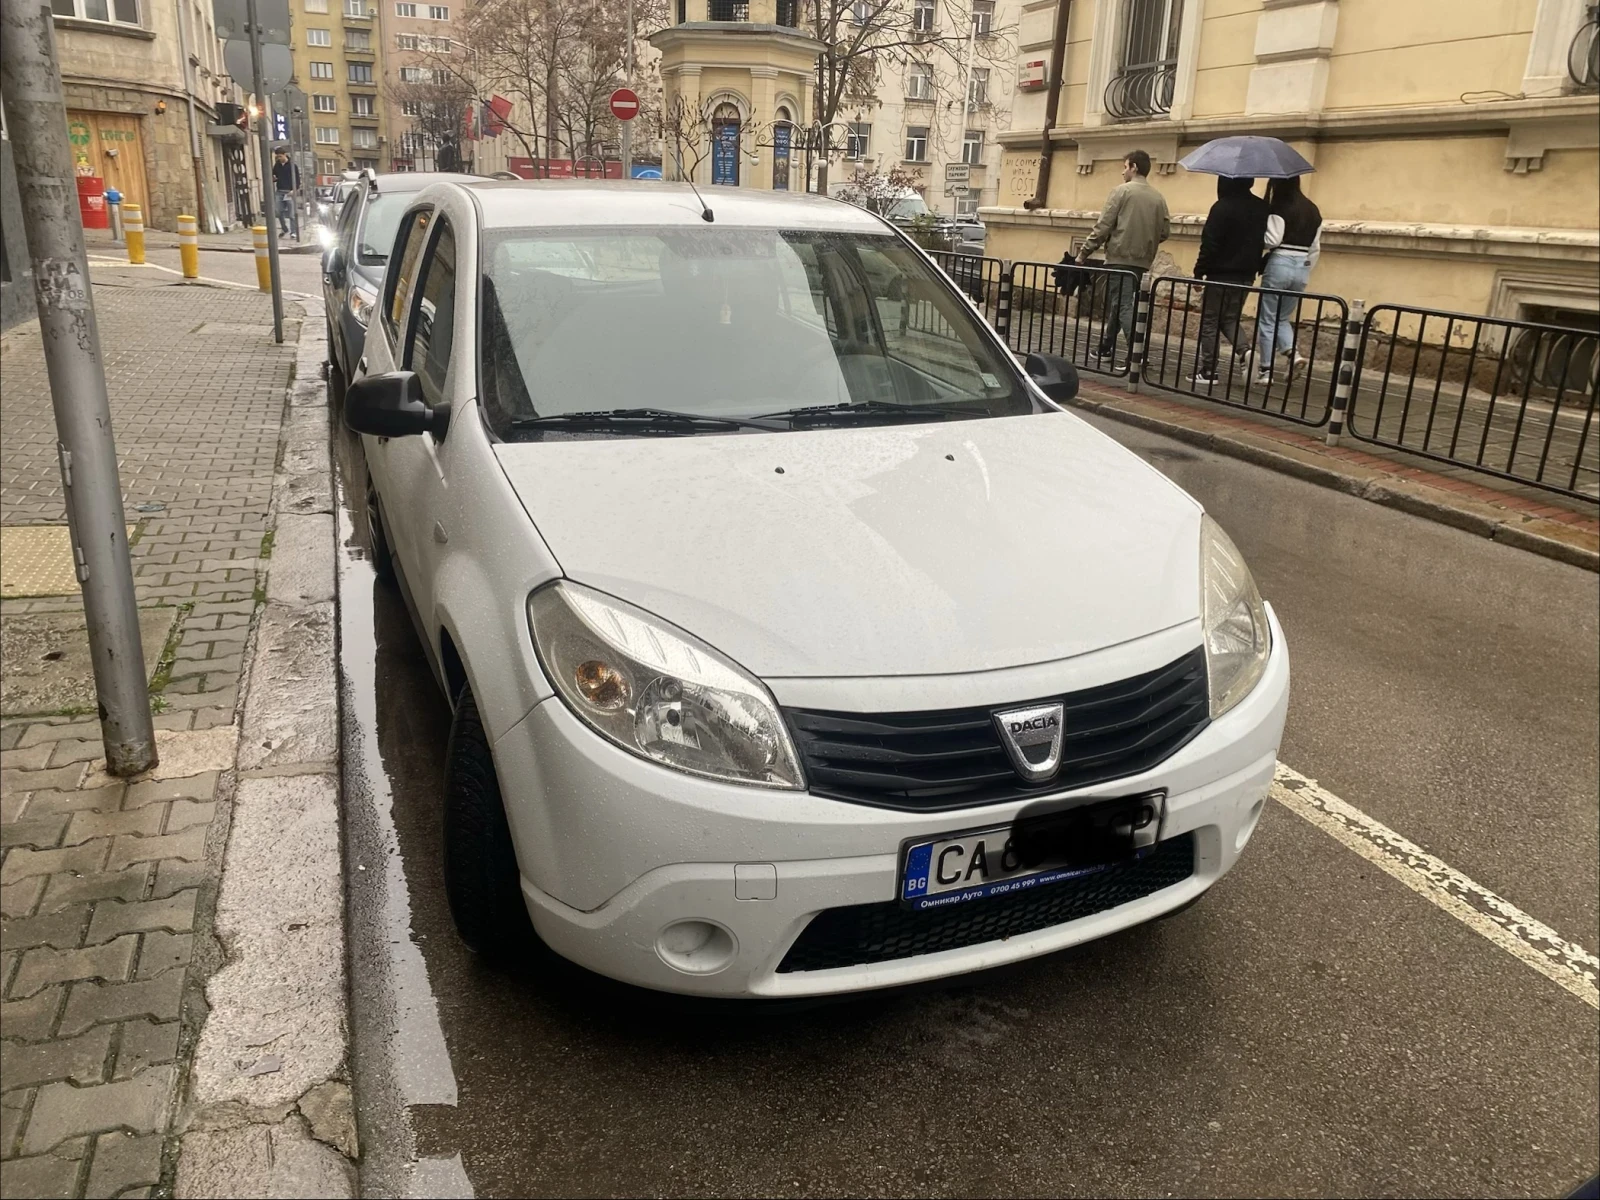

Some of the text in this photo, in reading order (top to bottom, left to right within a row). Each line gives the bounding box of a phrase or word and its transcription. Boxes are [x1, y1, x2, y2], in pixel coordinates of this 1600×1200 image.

[1010, 177, 1035, 192] COST
[1010, 716, 1058, 733] DACIA
[907, 877, 926, 892] BG
[920, 895, 960, 908] Омникар
[962, 890, 983, 901] Ауто
[990, 884, 1010, 895] 0700
[1010, 881, 1021, 890] 45
[1022, 878, 1036, 887] 999
